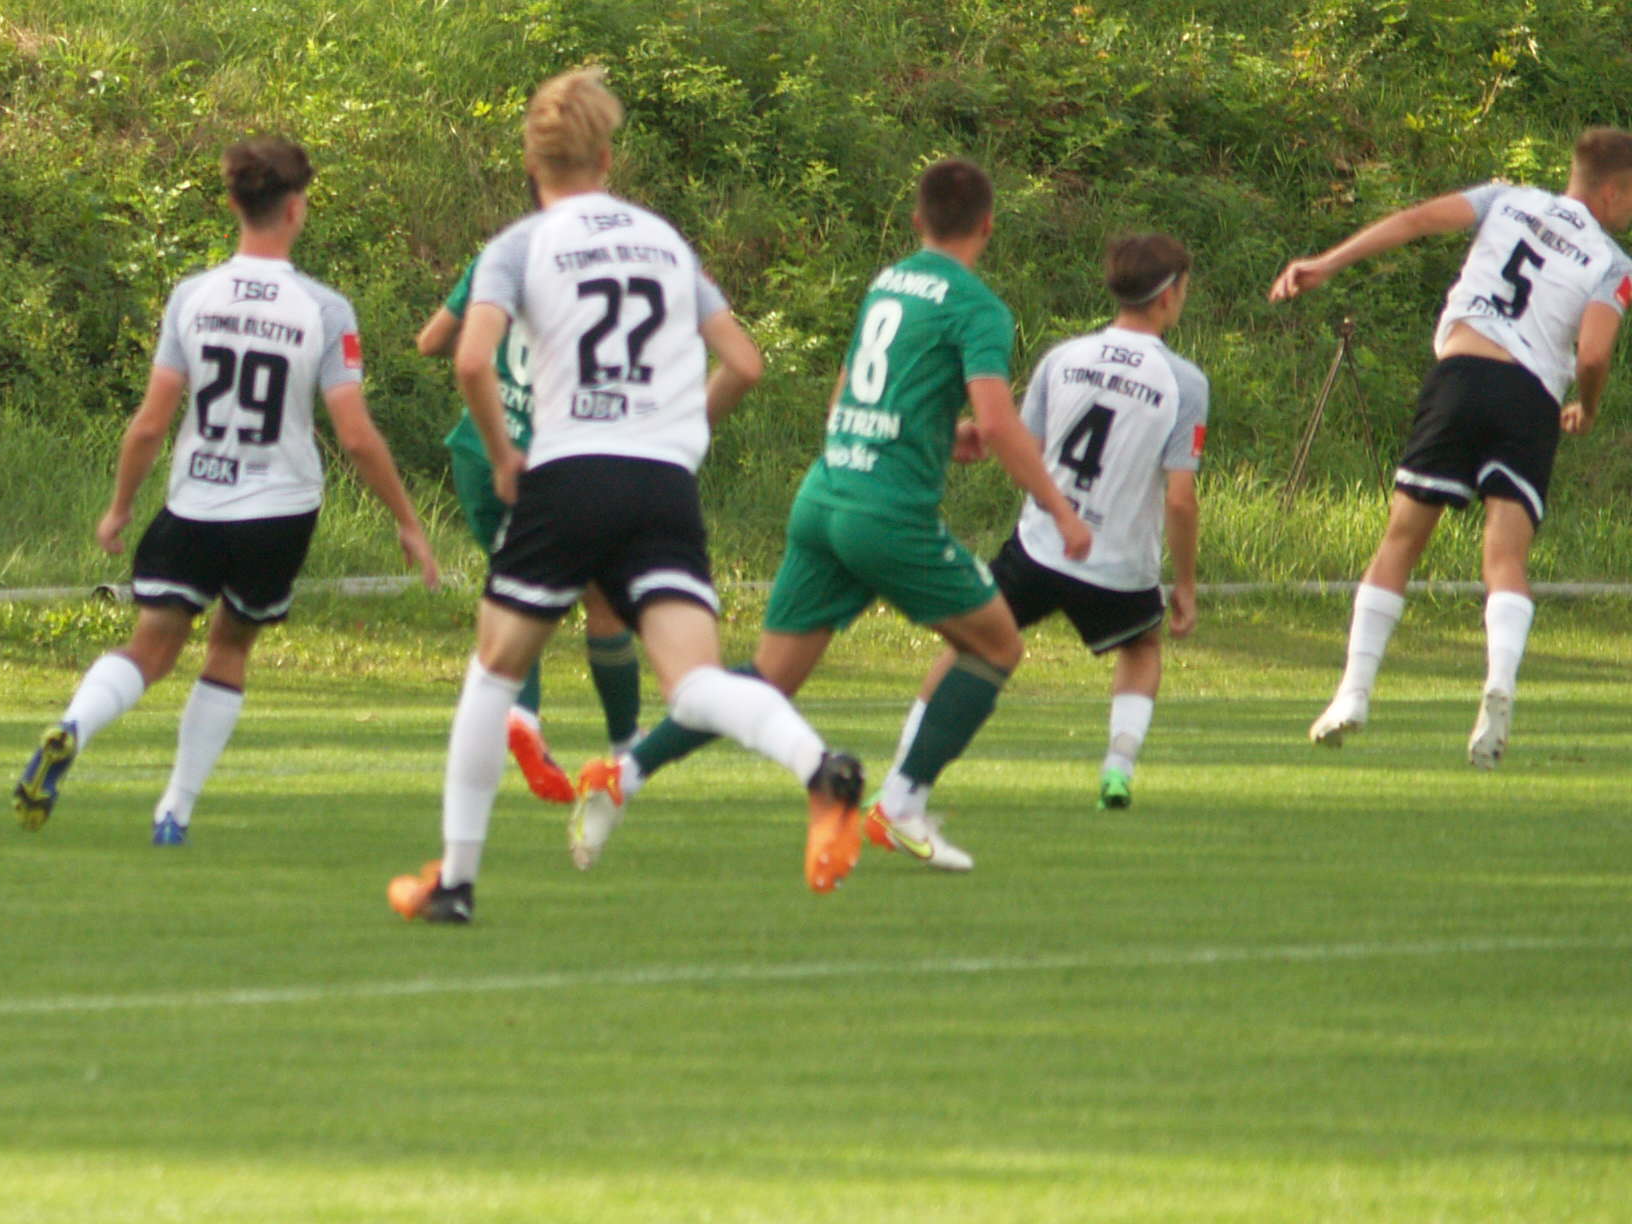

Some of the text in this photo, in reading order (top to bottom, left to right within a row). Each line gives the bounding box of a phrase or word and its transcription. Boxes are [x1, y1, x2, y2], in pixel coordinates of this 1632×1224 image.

[231, 278, 279, 302] TSG
[1491, 237, 1546, 320] 5
[577, 277, 666, 389] 22
[850, 298, 903, 405] 8
[1101, 343, 1145, 368] TSG
[196, 344, 289, 446] 29
[1058, 402, 1116, 492] 4
